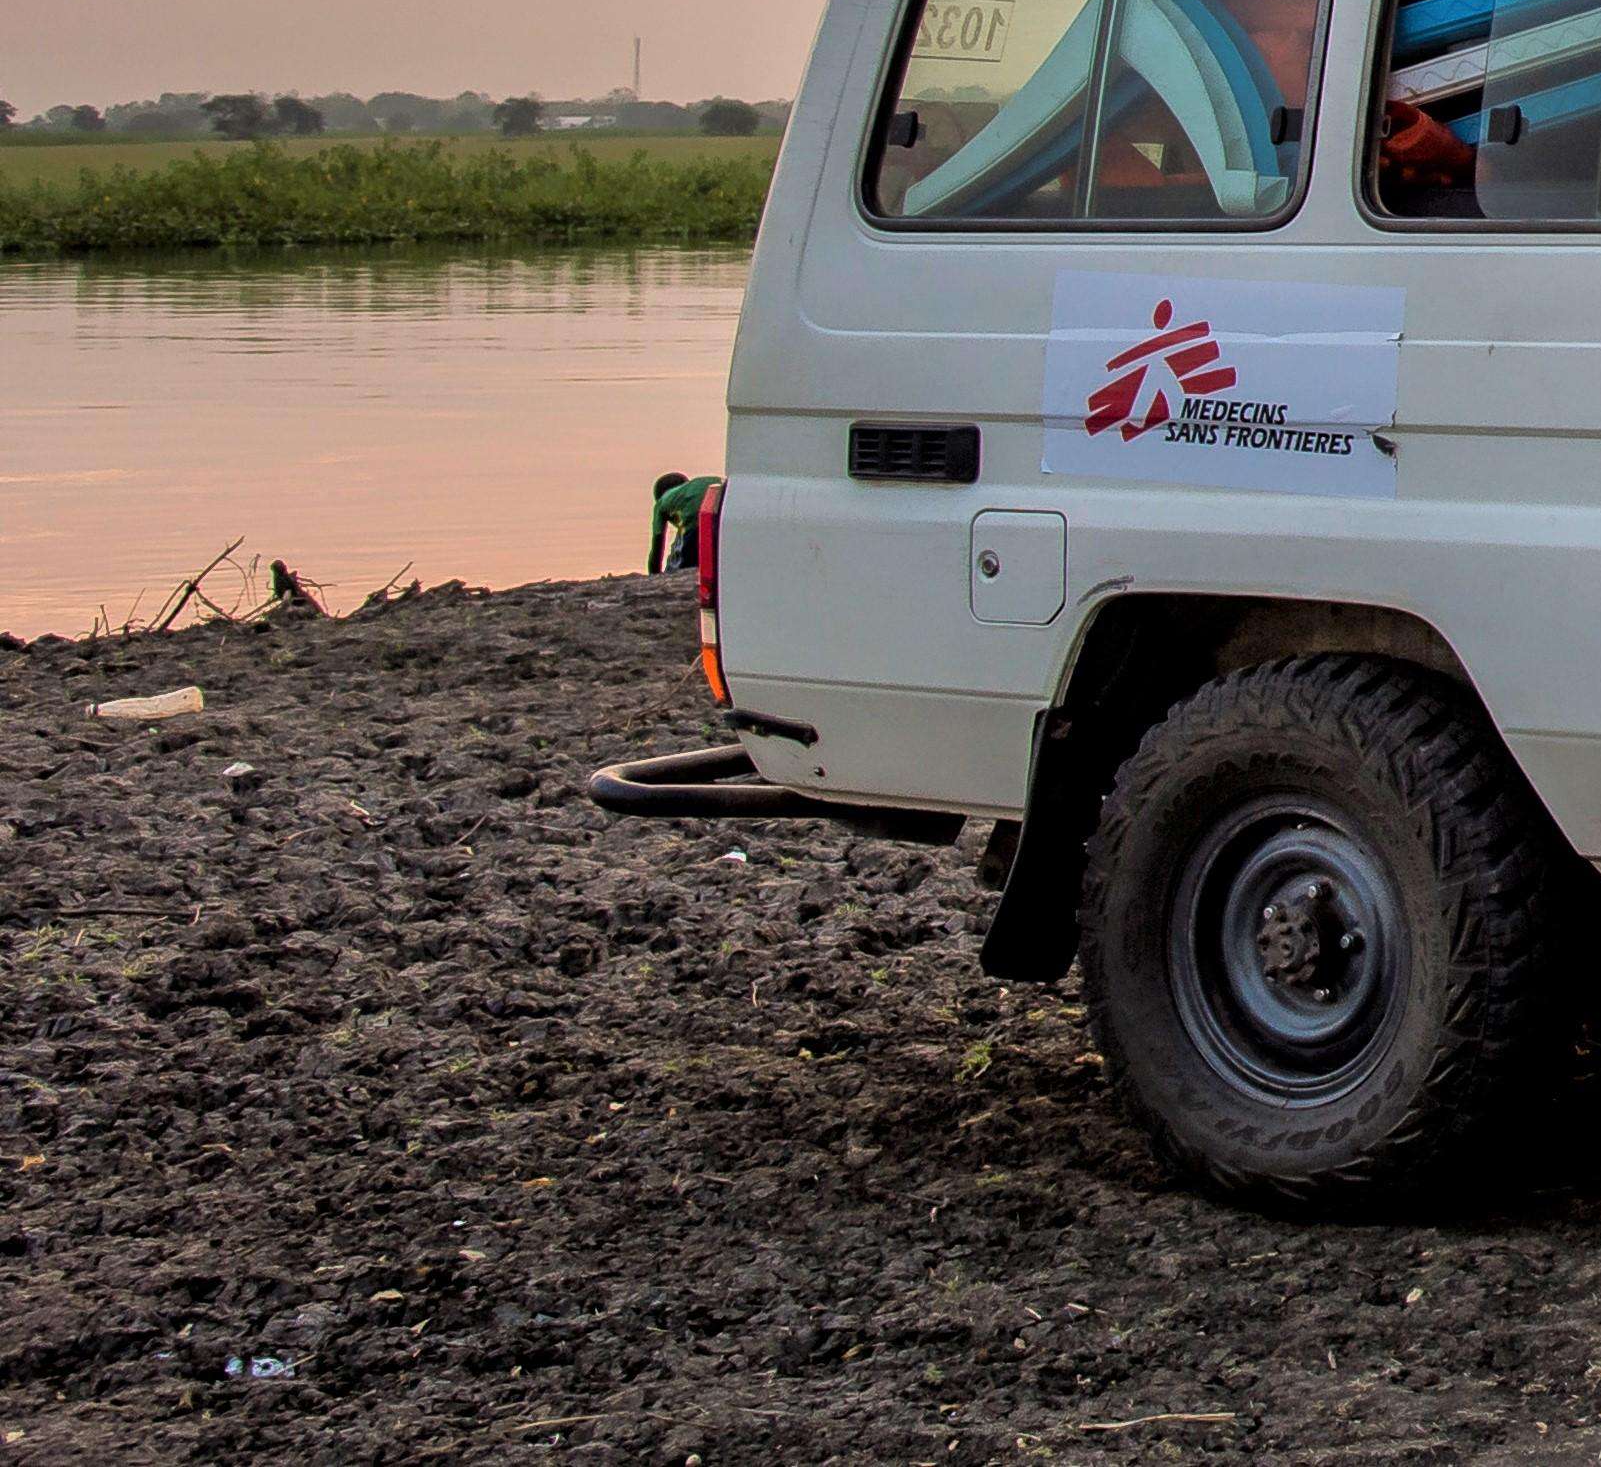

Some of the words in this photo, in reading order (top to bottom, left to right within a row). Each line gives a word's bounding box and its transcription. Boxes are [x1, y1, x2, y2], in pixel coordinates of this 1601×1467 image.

[1180, 397, 1288, 425] MEDECINS
[1165, 422, 1220, 445] SANS
[1224, 425, 1354, 455] FRONTIERES
